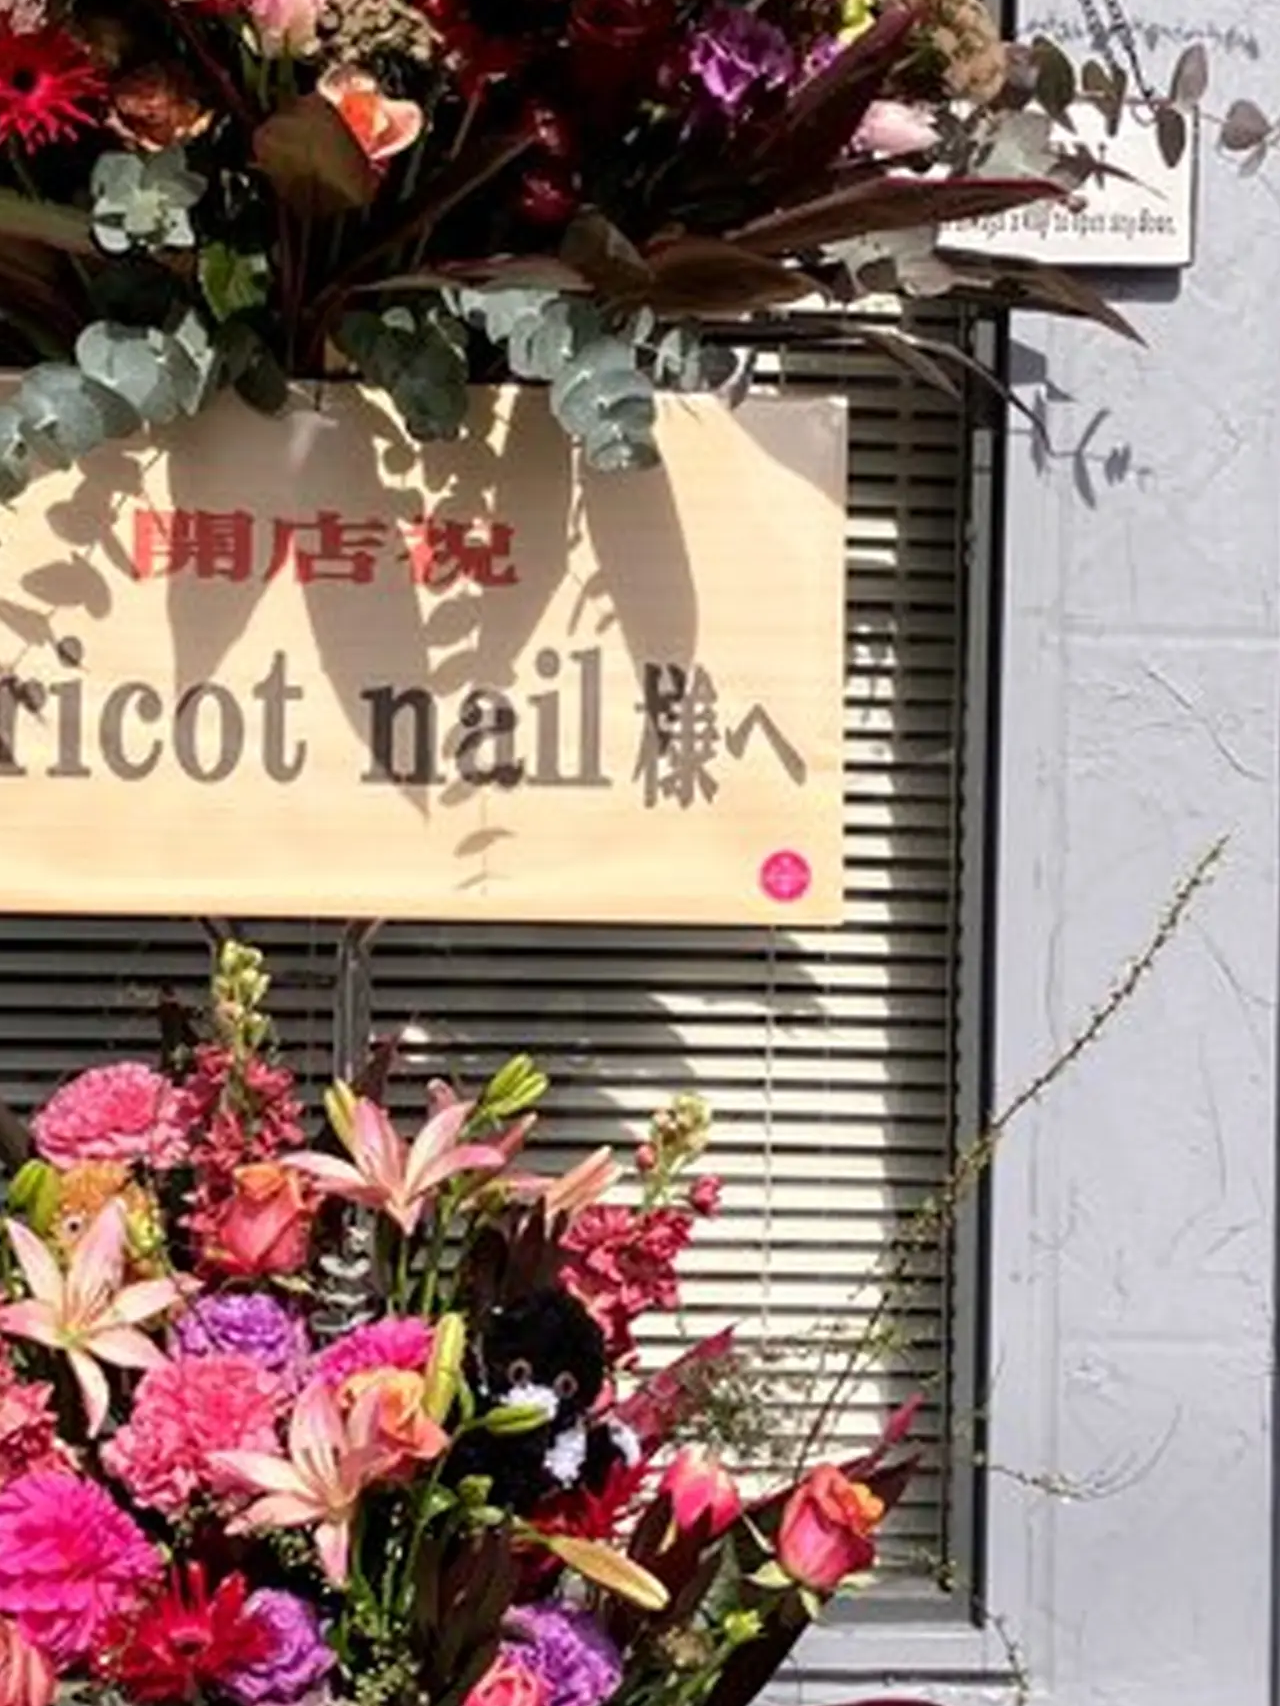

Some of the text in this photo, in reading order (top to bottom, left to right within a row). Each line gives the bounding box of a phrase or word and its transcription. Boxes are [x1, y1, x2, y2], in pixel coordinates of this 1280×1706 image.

[130, 509, 519, 587] 開店祝
[362, 648, 614, 790] nail
